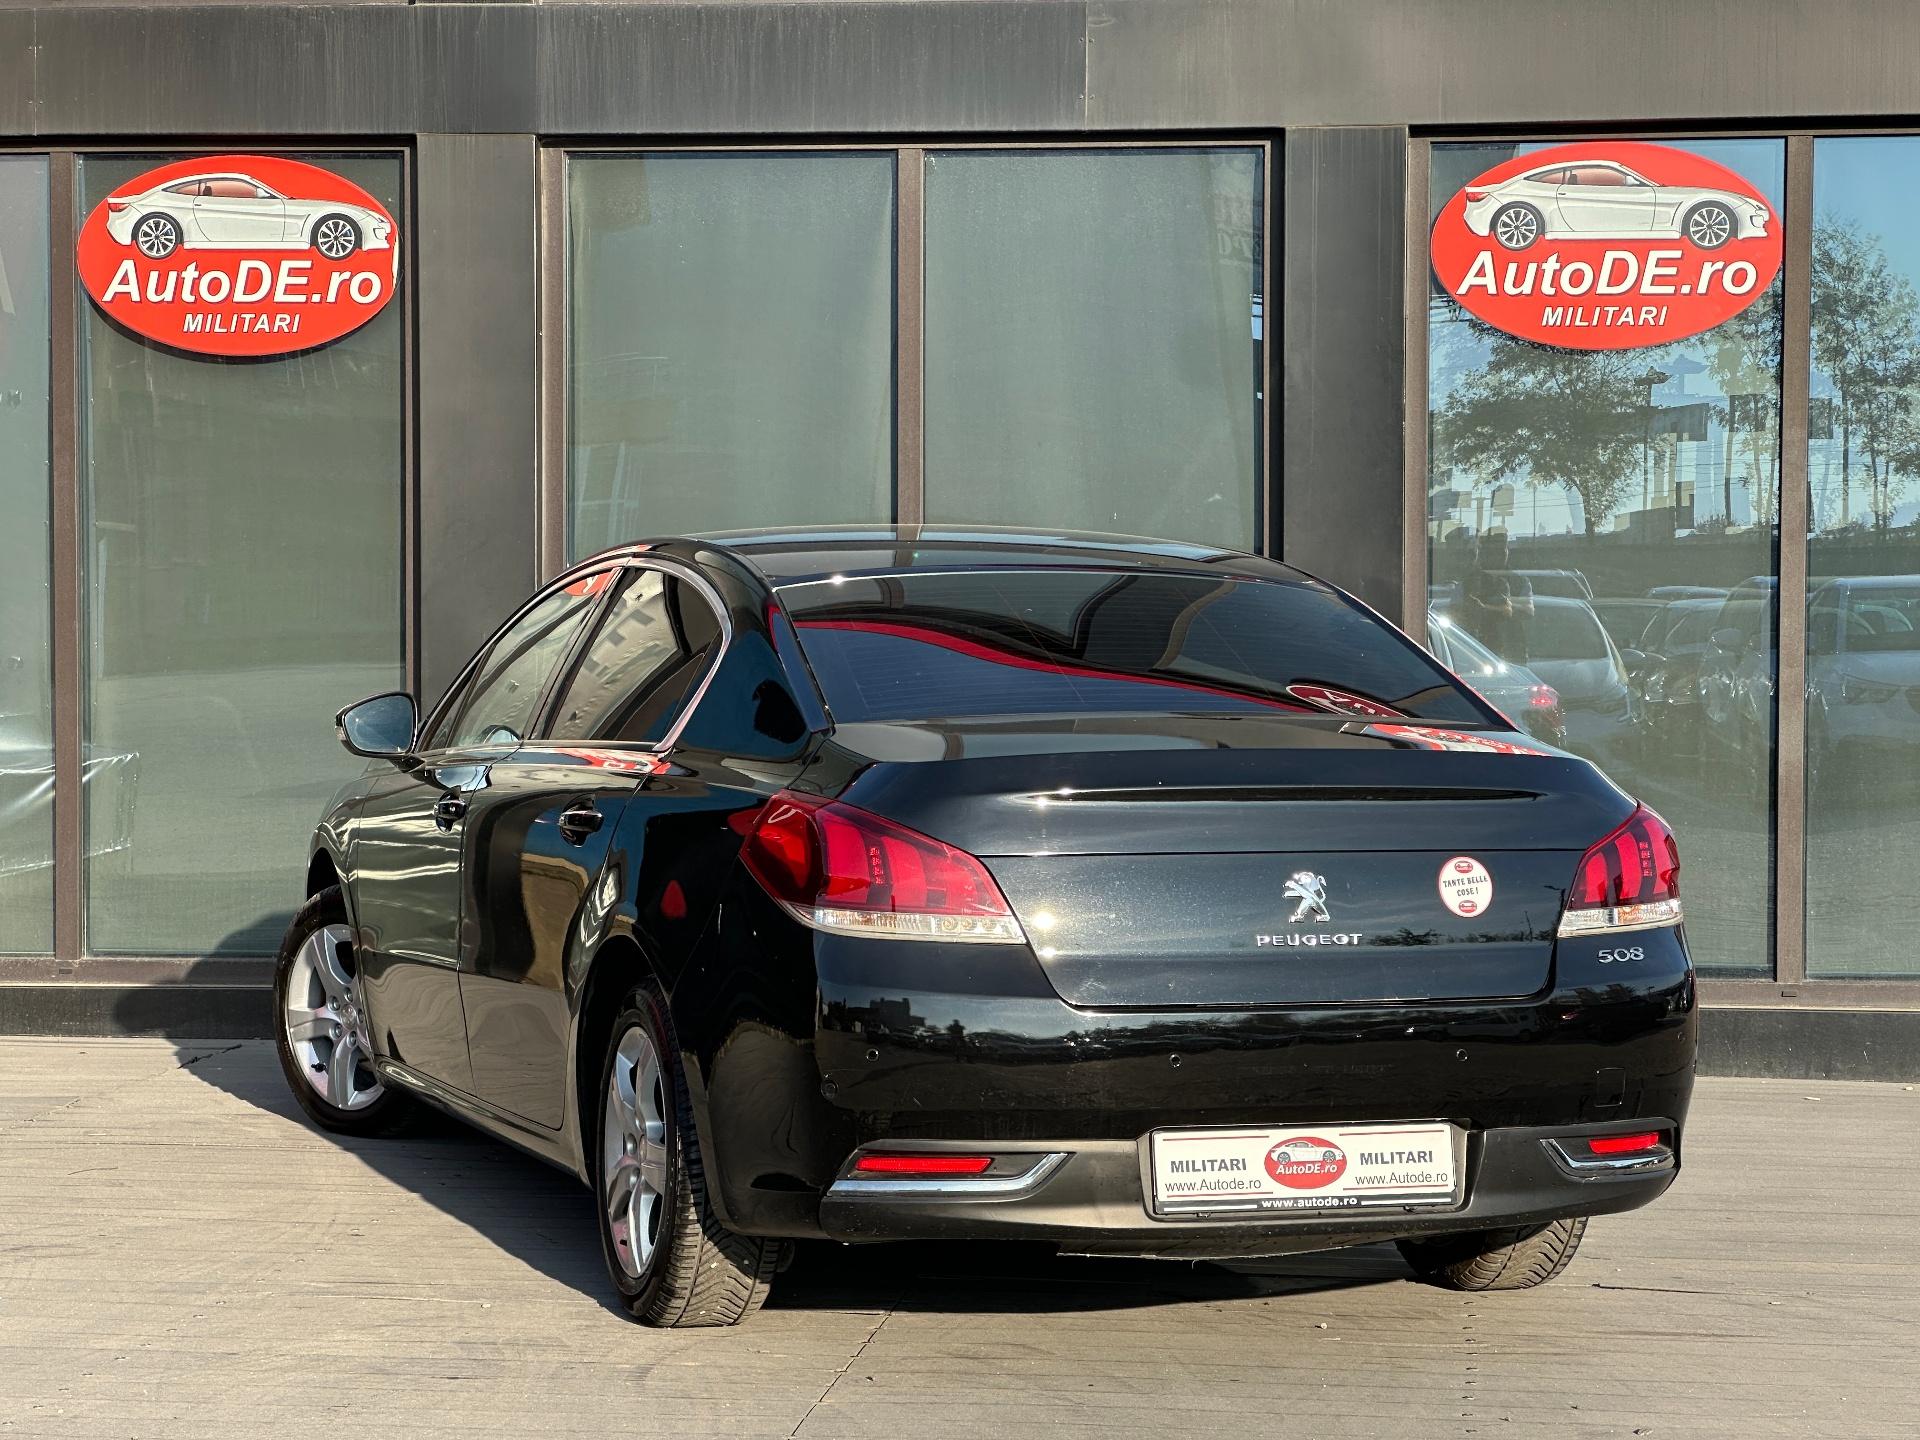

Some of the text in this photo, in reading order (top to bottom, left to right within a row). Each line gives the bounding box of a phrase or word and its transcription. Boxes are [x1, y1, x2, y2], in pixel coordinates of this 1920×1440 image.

[1455, 249, 1758, 297] AutoDE.ro
[101, 259, 382, 304] AutoDE.ro
[183, 313, 300, 334] MILITARI
[1541, 306, 1669, 327] MILITARI
[1443, 875, 1488, 888] TANTE BELLE
[1256, 933, 1363, 947] PEUGEOT
[1598, 946, 1645, 963] 508
[1360, 1150, 1433, 1165] MILITARI
[1170, 1158, 1247, 1174] MILITARI
[1275, 1163, 1338, 1175] AutoDE.ro
[1165, 1177, 1262, 1192] www.Autode.ro
[1355, 1171, 1448, 1185] www.Autode.ro
[1261, 1196, 1358, 1208] www.autode.ro
